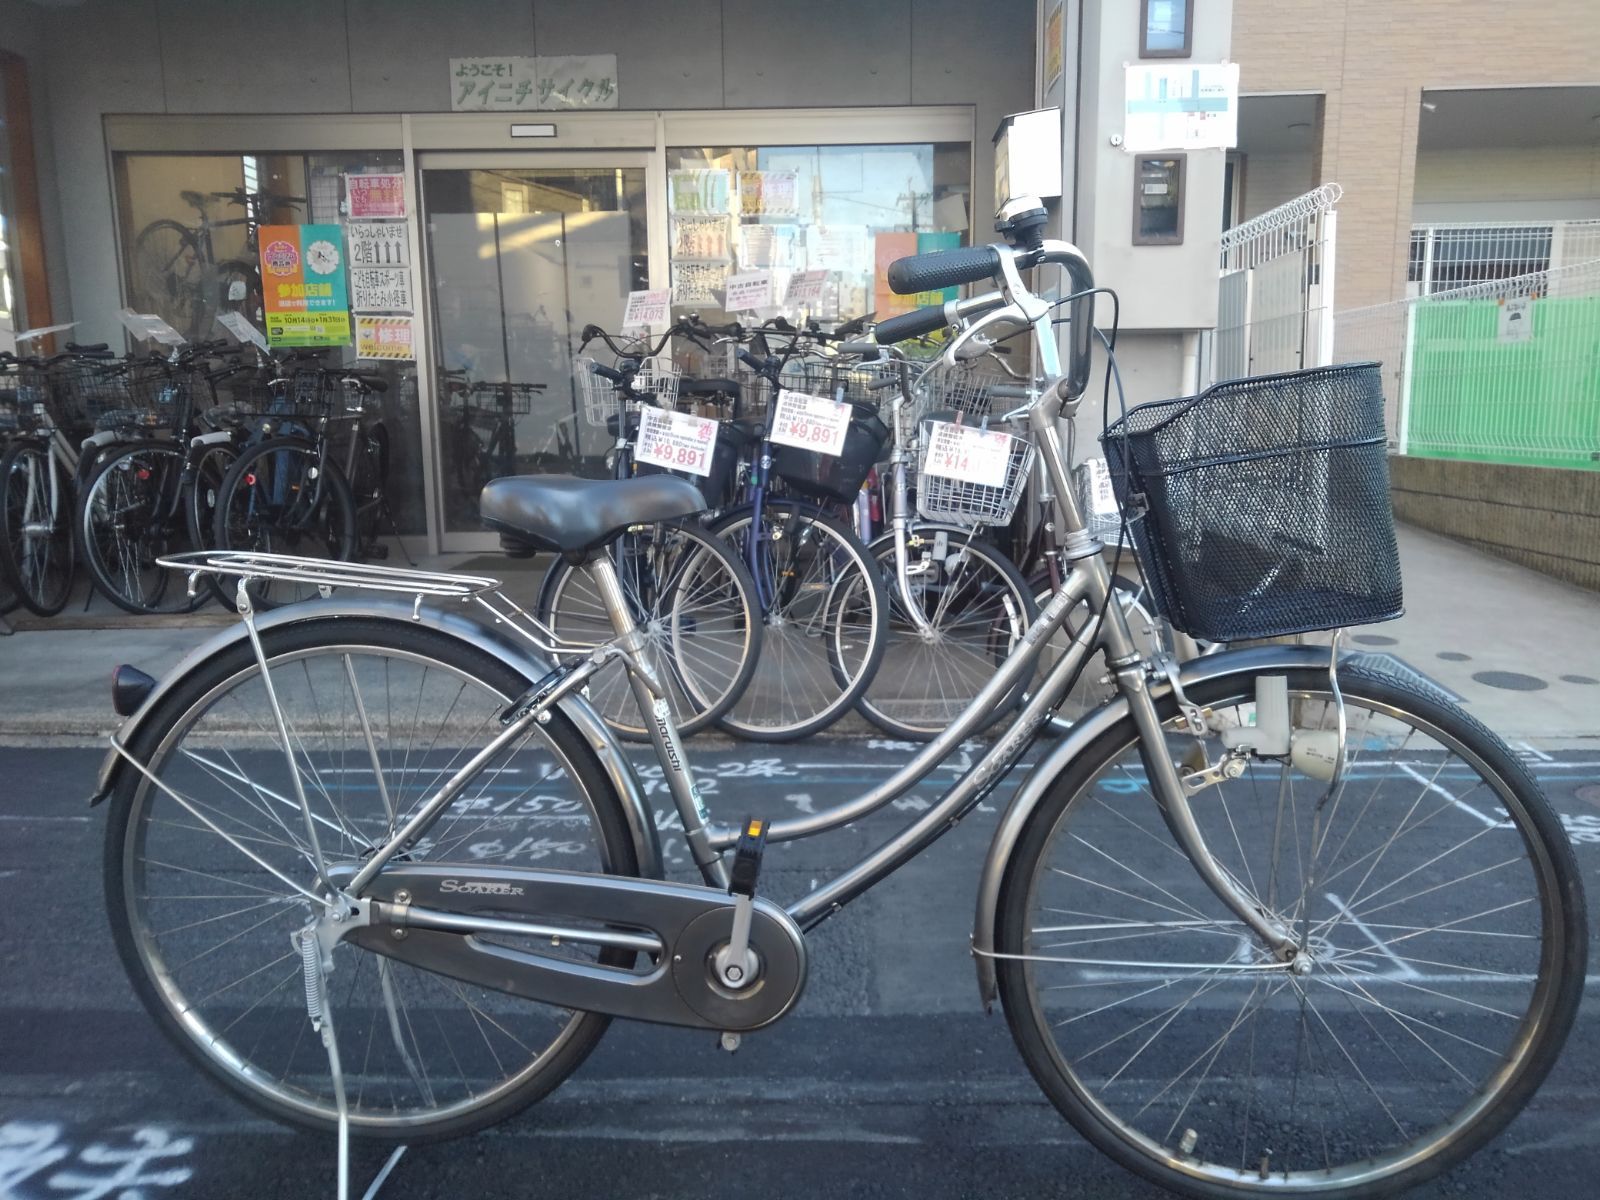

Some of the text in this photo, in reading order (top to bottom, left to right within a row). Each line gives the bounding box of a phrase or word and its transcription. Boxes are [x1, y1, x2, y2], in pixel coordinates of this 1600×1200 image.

[455, 63, 513, 77] ようこそ!
[456, 77, 615, 105] アイニチサイクル
[351, 225, 402, 239] いらっしゃいませ
[354, 240, 373, 264] 2階
[277, 283, 333, 298] 参加店舗
[378, 327, 411, 344] 修理
[789, 421, 840, 446] ¥9,891
[653, 442, 706, 472] ¥9,891
[440, 879, 525, 896] SOARER
